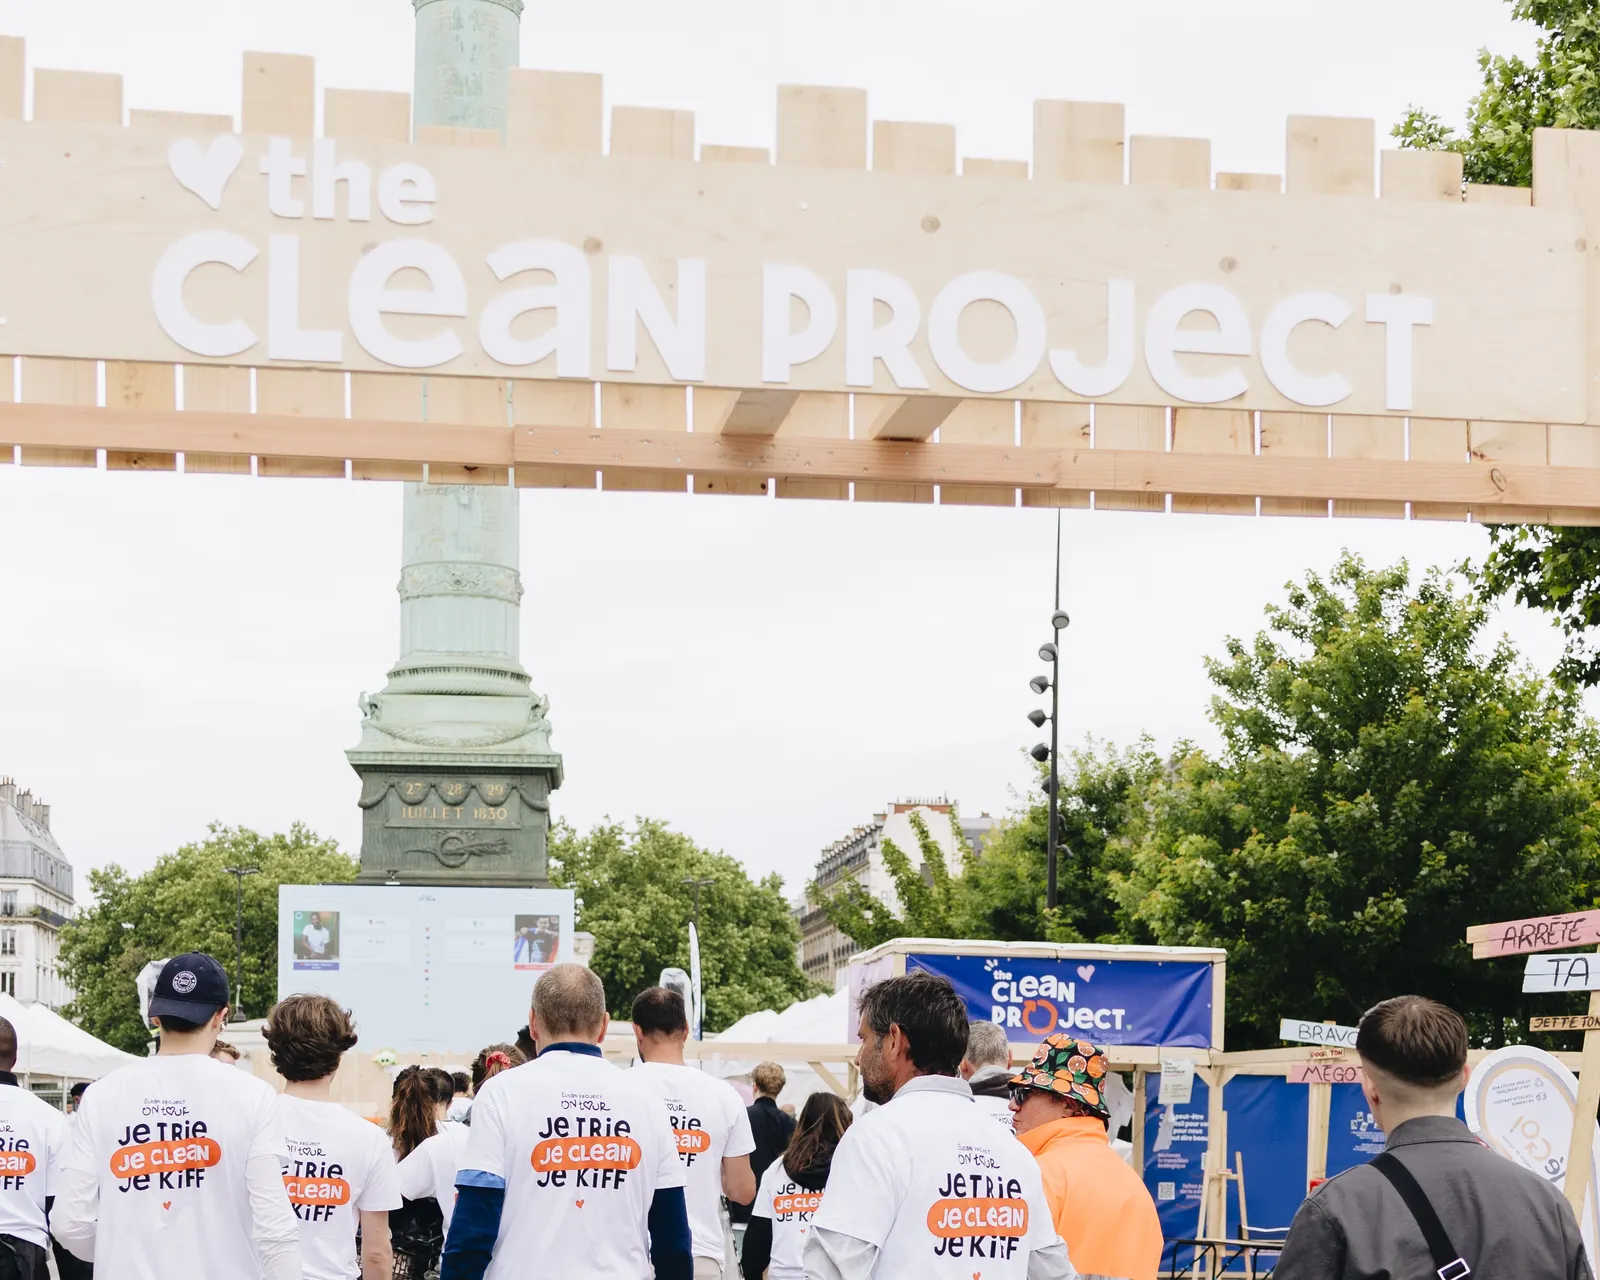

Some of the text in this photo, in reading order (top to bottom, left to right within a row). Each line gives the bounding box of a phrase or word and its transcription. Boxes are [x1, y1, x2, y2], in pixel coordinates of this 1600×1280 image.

[259, 136, 437, 225] the
[406, 783, 503, 796] 27 28 29
[474, 807, 507, 820] 1830
[993, 970, 1013, 980] the
[1547, 957, 1589, 987] TA
[1533, 1016, 1579, 1029] JETTE
[142, 1105, 159, 1116] ON
[561, 1100, 577, 1109] ON
[538, 1116, 569, 1138] Je
[670, 1116, 702, 1131] Rie
[118, 1123, 151, 1146] Je
[0, 1137, 29, 1152] Rie
[118, 1151, 145, 1172] Je
[540, 1145, 563, 1165] Je
[1, 1175, 25, 1191] FF
[119, 1174, 151, 1193] Je
[537, 1169, 567, 1188] Je
[939, 1173, 967, 1198] Je
[777, 1182, 796, 1195] Je
[776, 1198, 792, 1210] Je
[777, 1211, 793, 1223] Je
[937, 1207, 962, 1229] Je
[934, 1236, 964, 1257] Je
